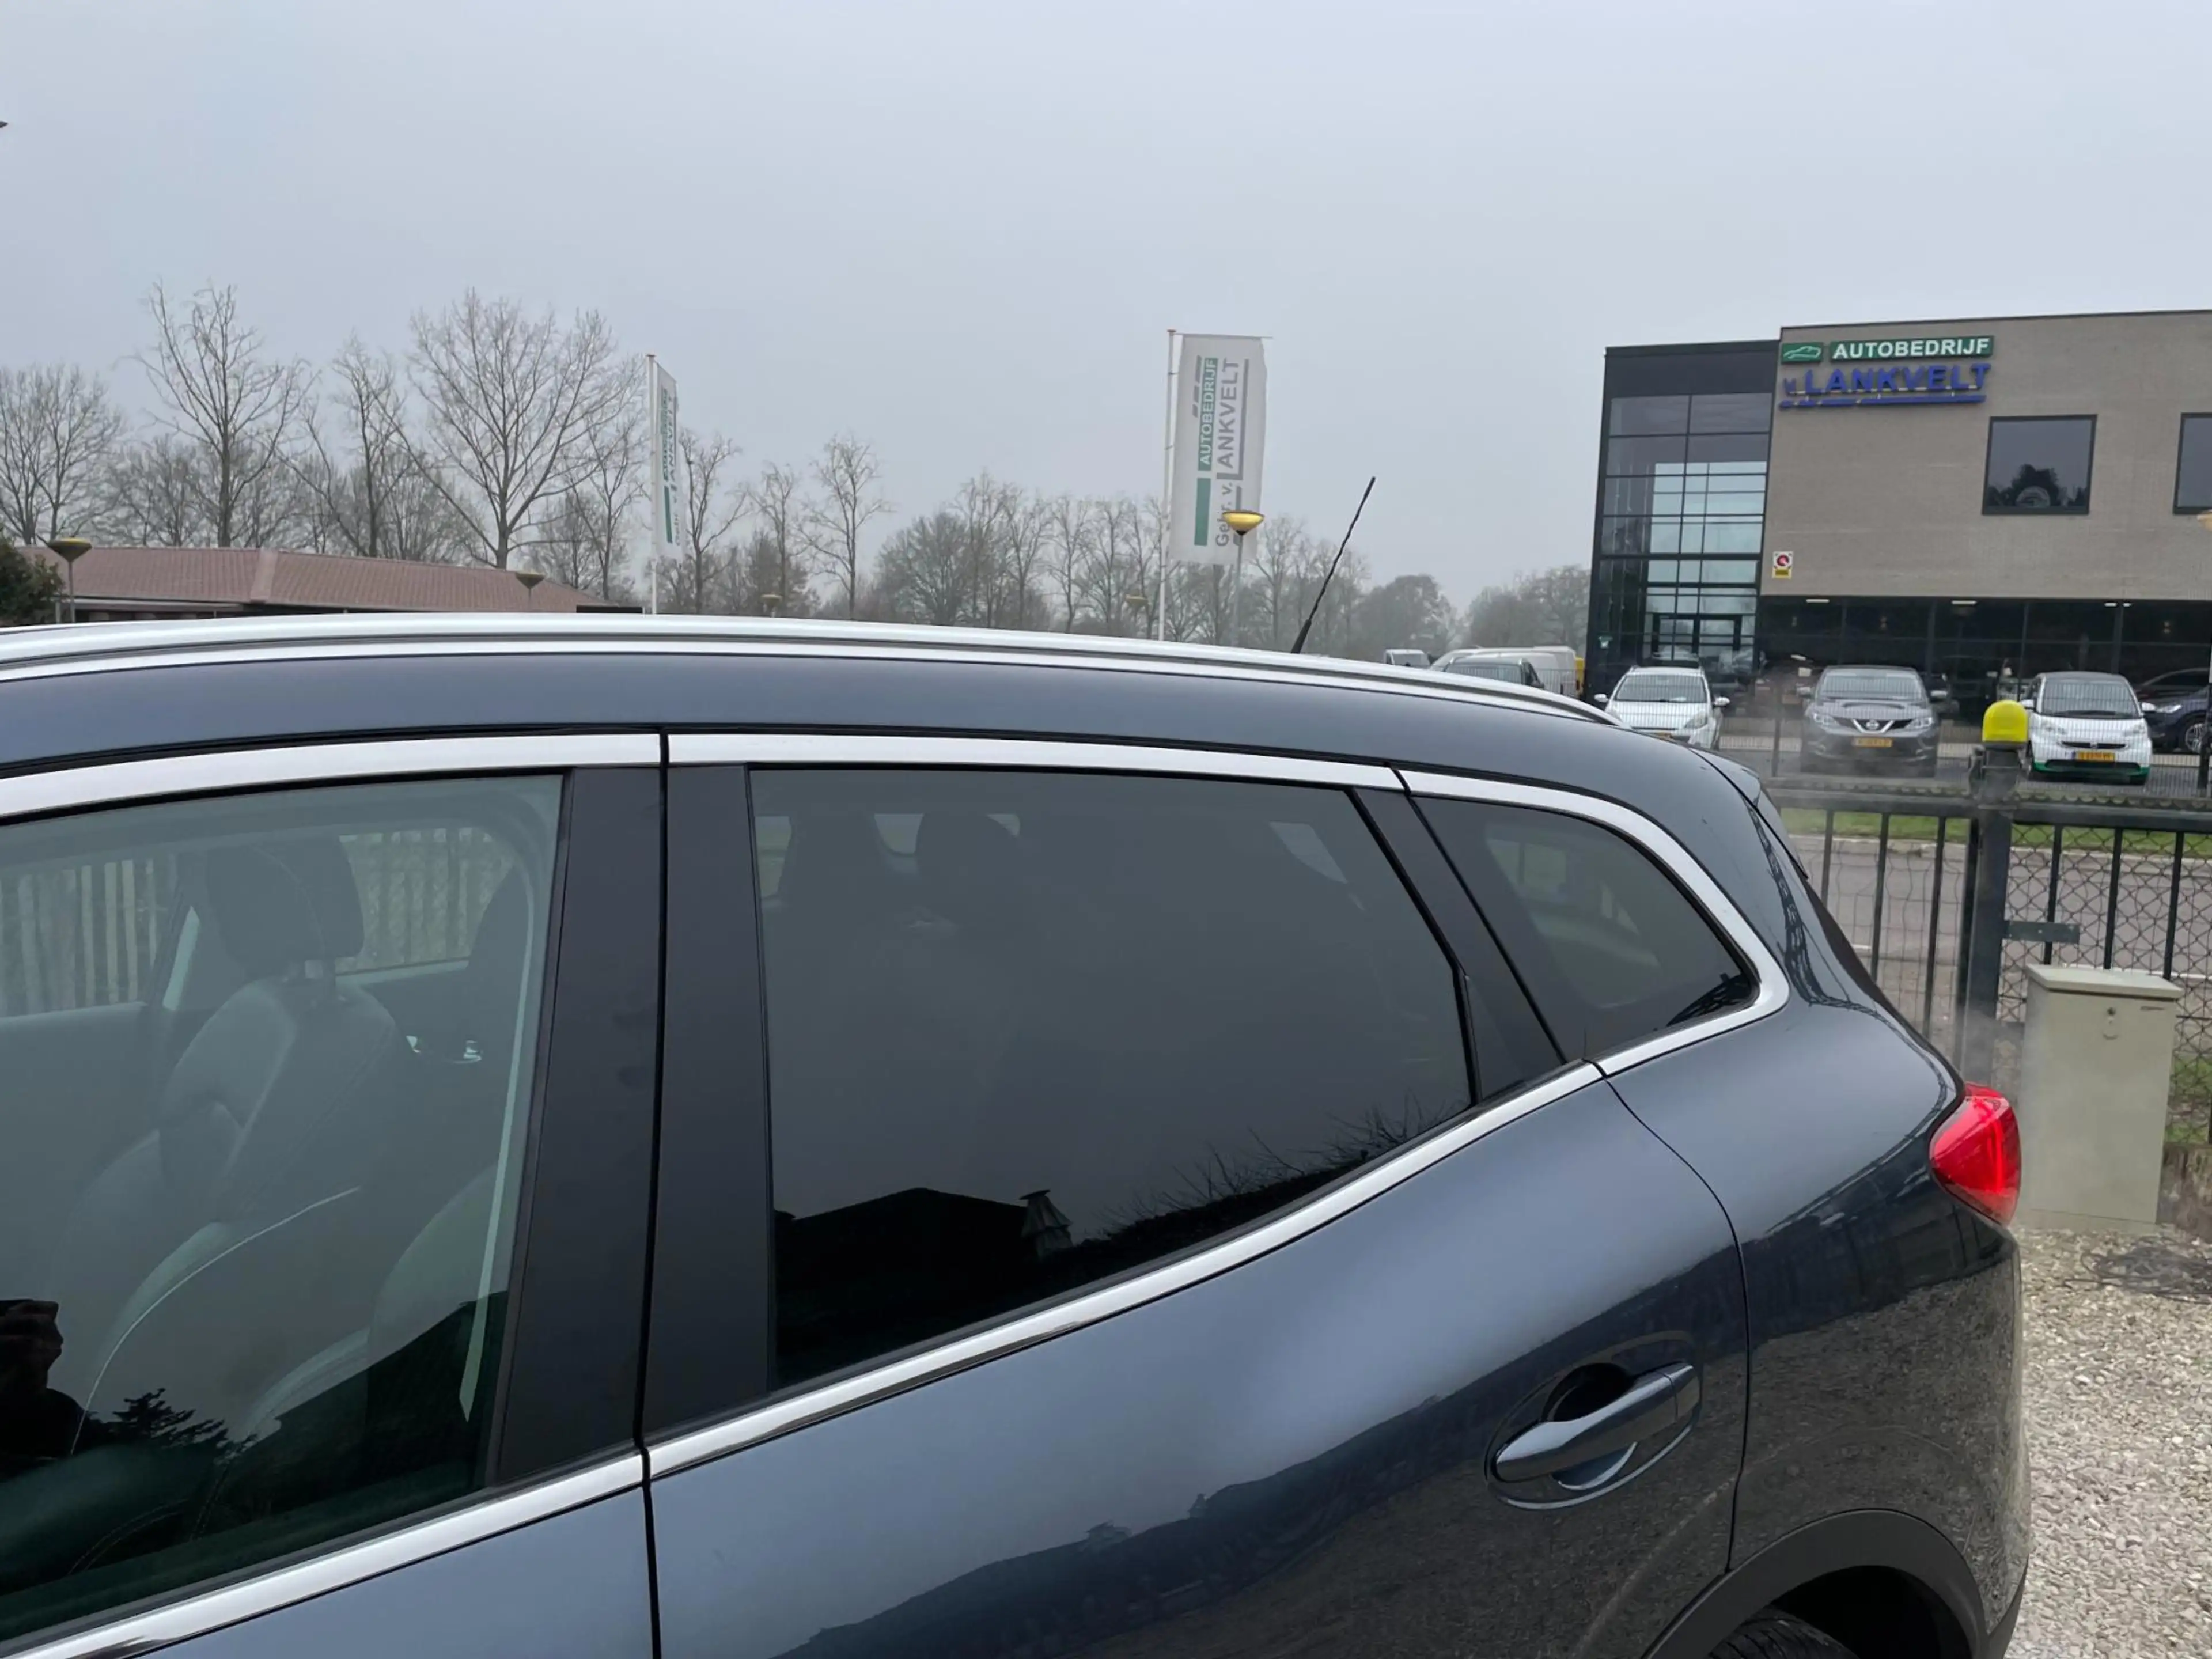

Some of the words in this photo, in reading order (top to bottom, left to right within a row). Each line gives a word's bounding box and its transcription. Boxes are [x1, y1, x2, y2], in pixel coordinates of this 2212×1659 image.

[1832, 338, 1990, 359] AUTOBEDRIJF
[1805, 363, 1991, 394] LANKVELT
[1199, 358, 1218, 465] AUTOBEDRIJF
